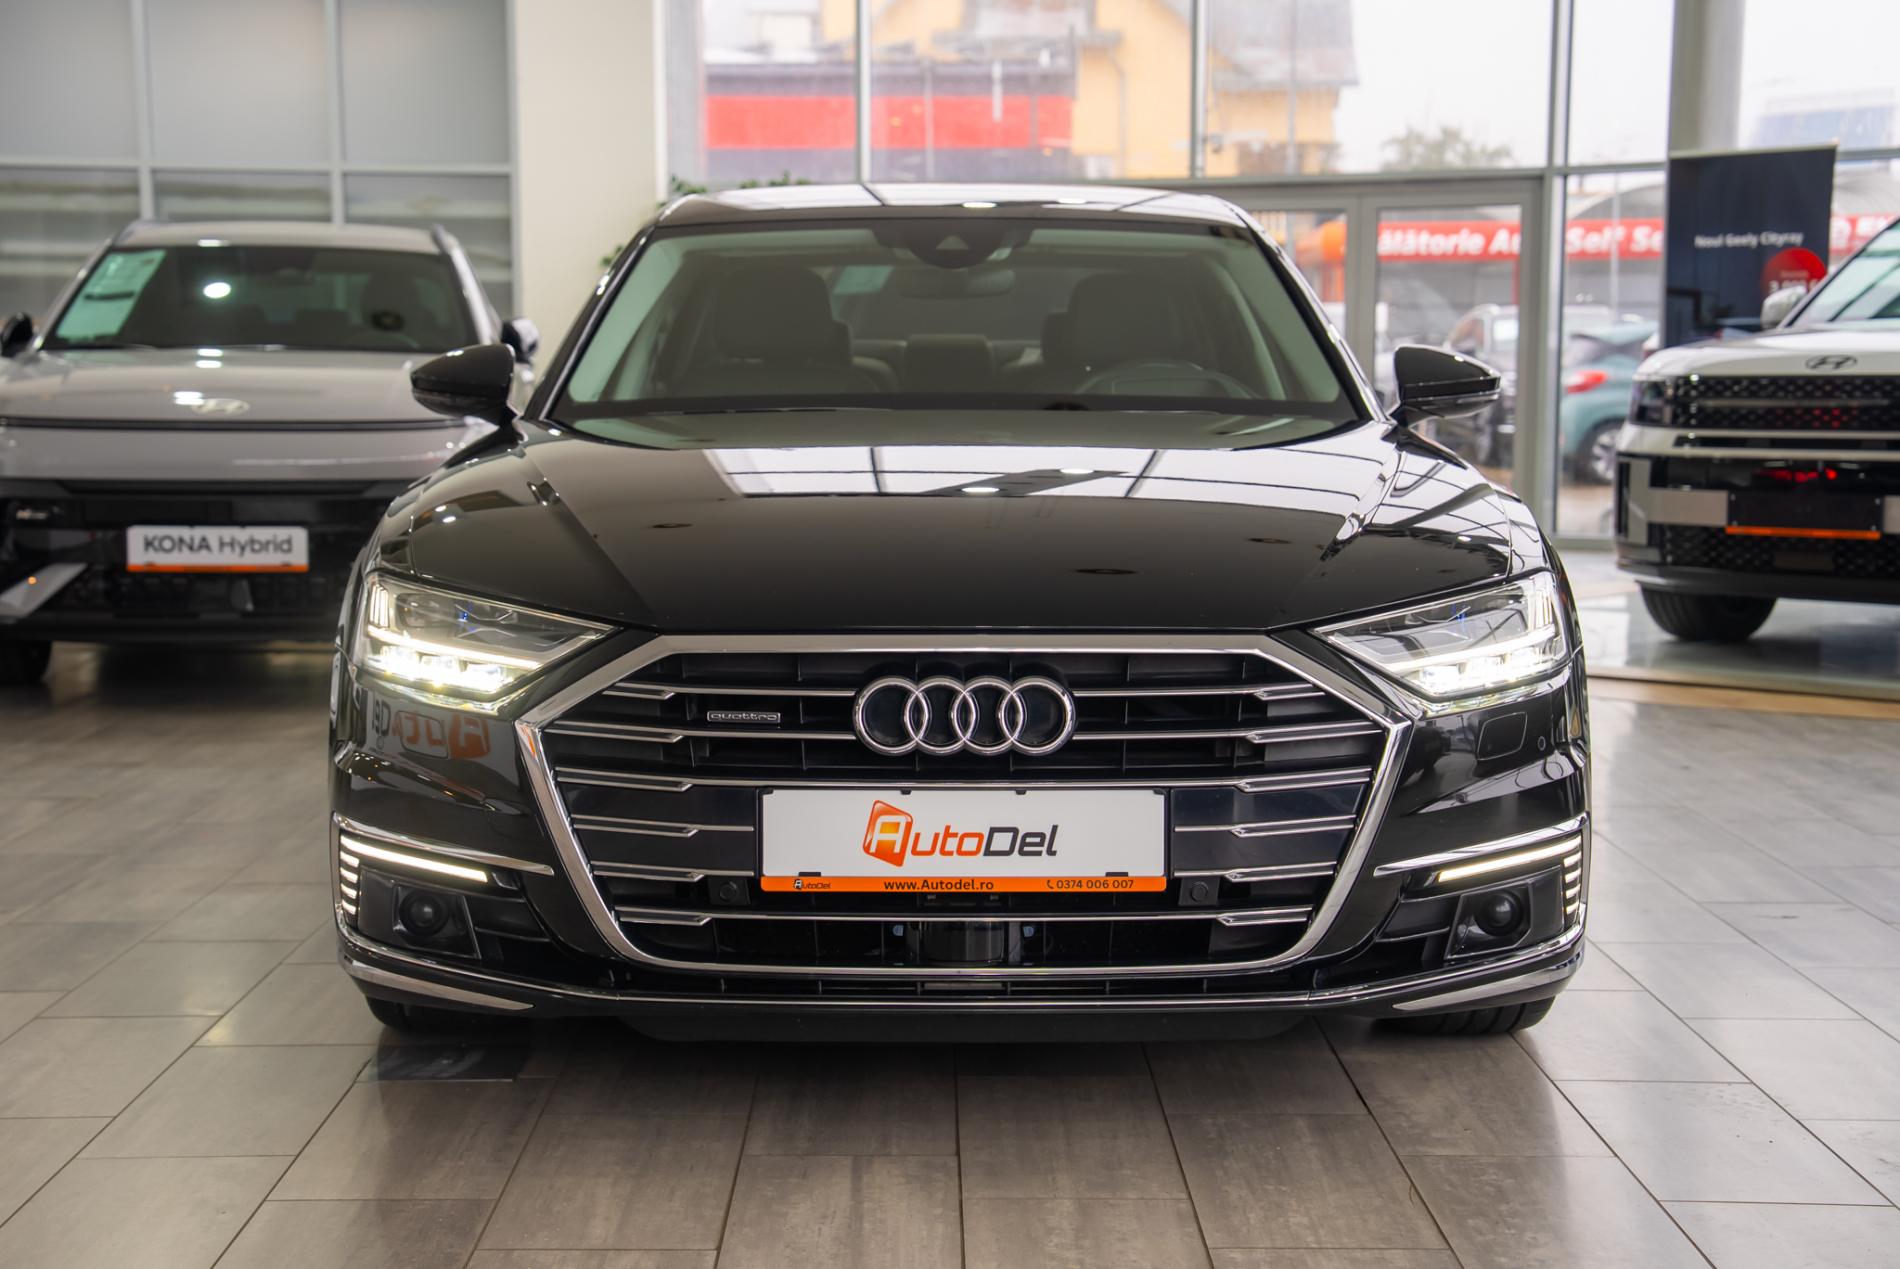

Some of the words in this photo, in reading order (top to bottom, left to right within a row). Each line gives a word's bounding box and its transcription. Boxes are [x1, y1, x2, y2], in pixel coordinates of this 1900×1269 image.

[143, 534, 212, 553] KONA
[218, 534, 293, 557] Hybrid
[863, 800, 1059, 868] AutoDel
[884, 879, 994, 890] www.Autodel.ro
[1056, 880, 1082, 889] 0374
[1086, 880, 1109, 889] 006
[1112, 880, 1134, 889] 007
